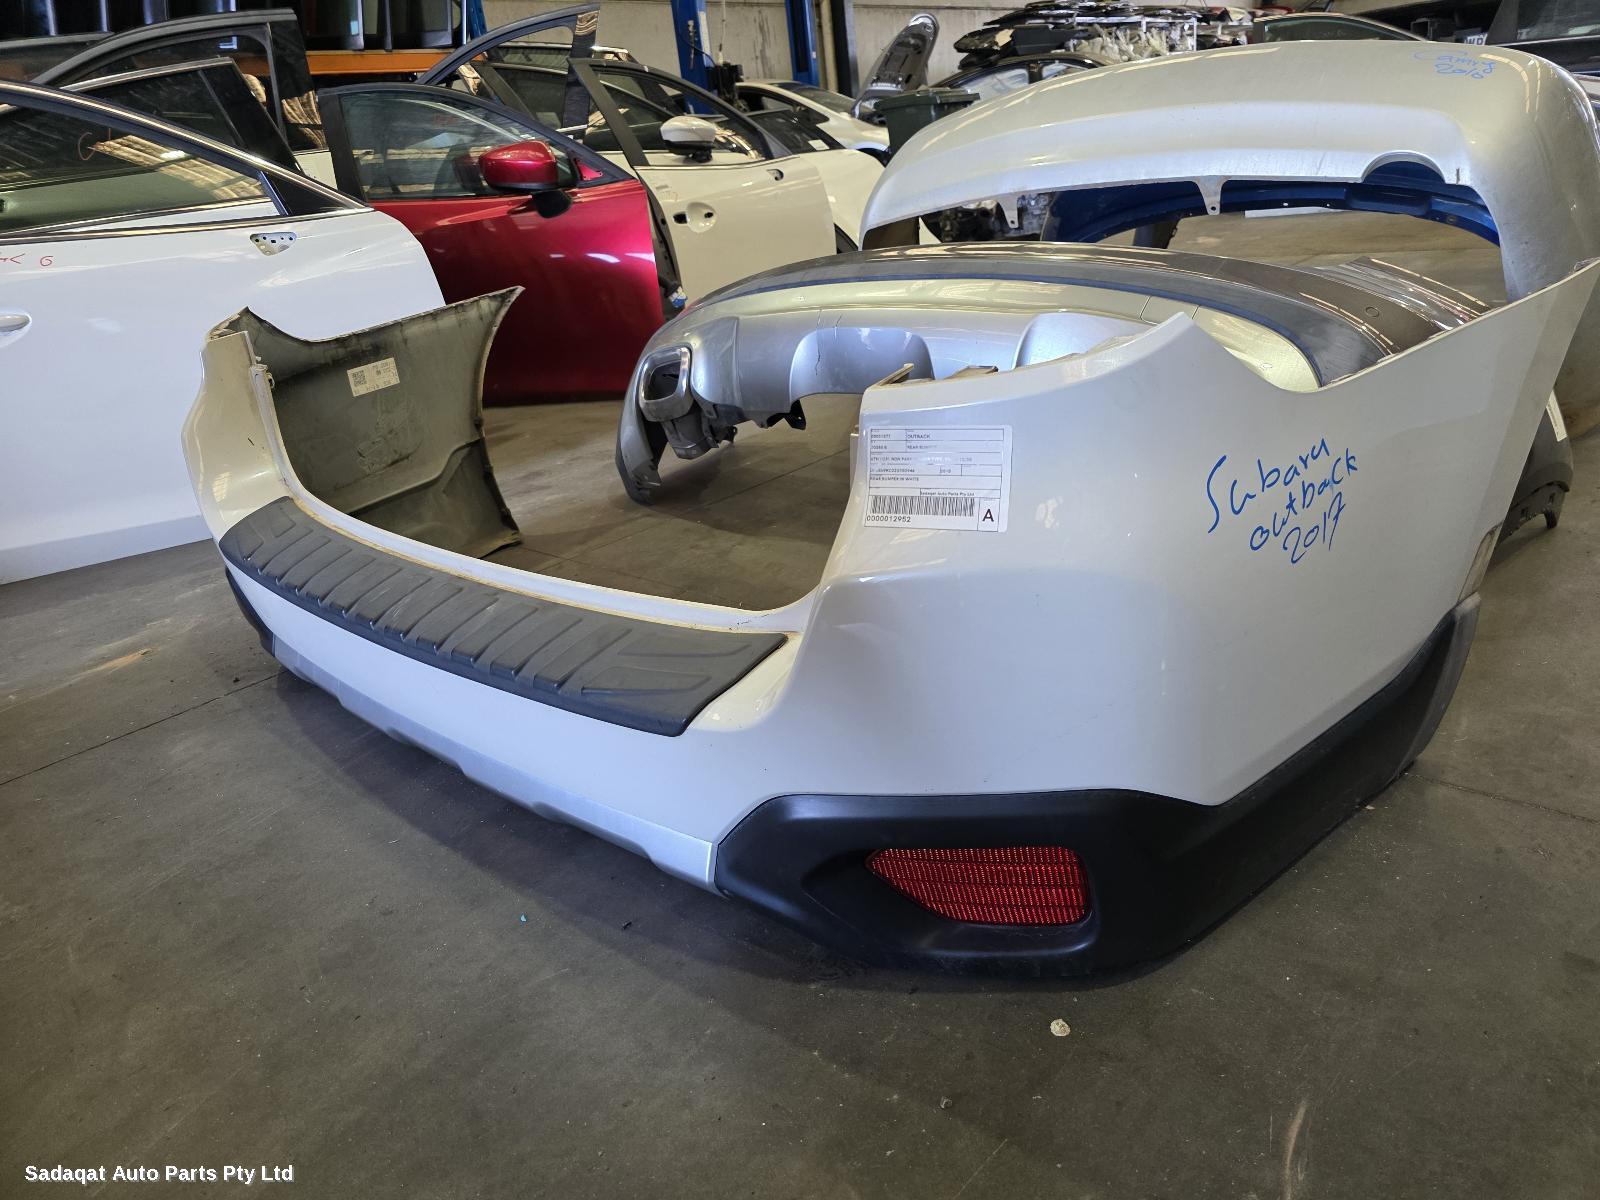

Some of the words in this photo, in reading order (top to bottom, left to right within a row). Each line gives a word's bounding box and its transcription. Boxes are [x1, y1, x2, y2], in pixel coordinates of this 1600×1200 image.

[982, 508, 994, 522] A
[1207, 438, 1330, 533] Subaru
[1283, 491, 1346, 564] 2017
